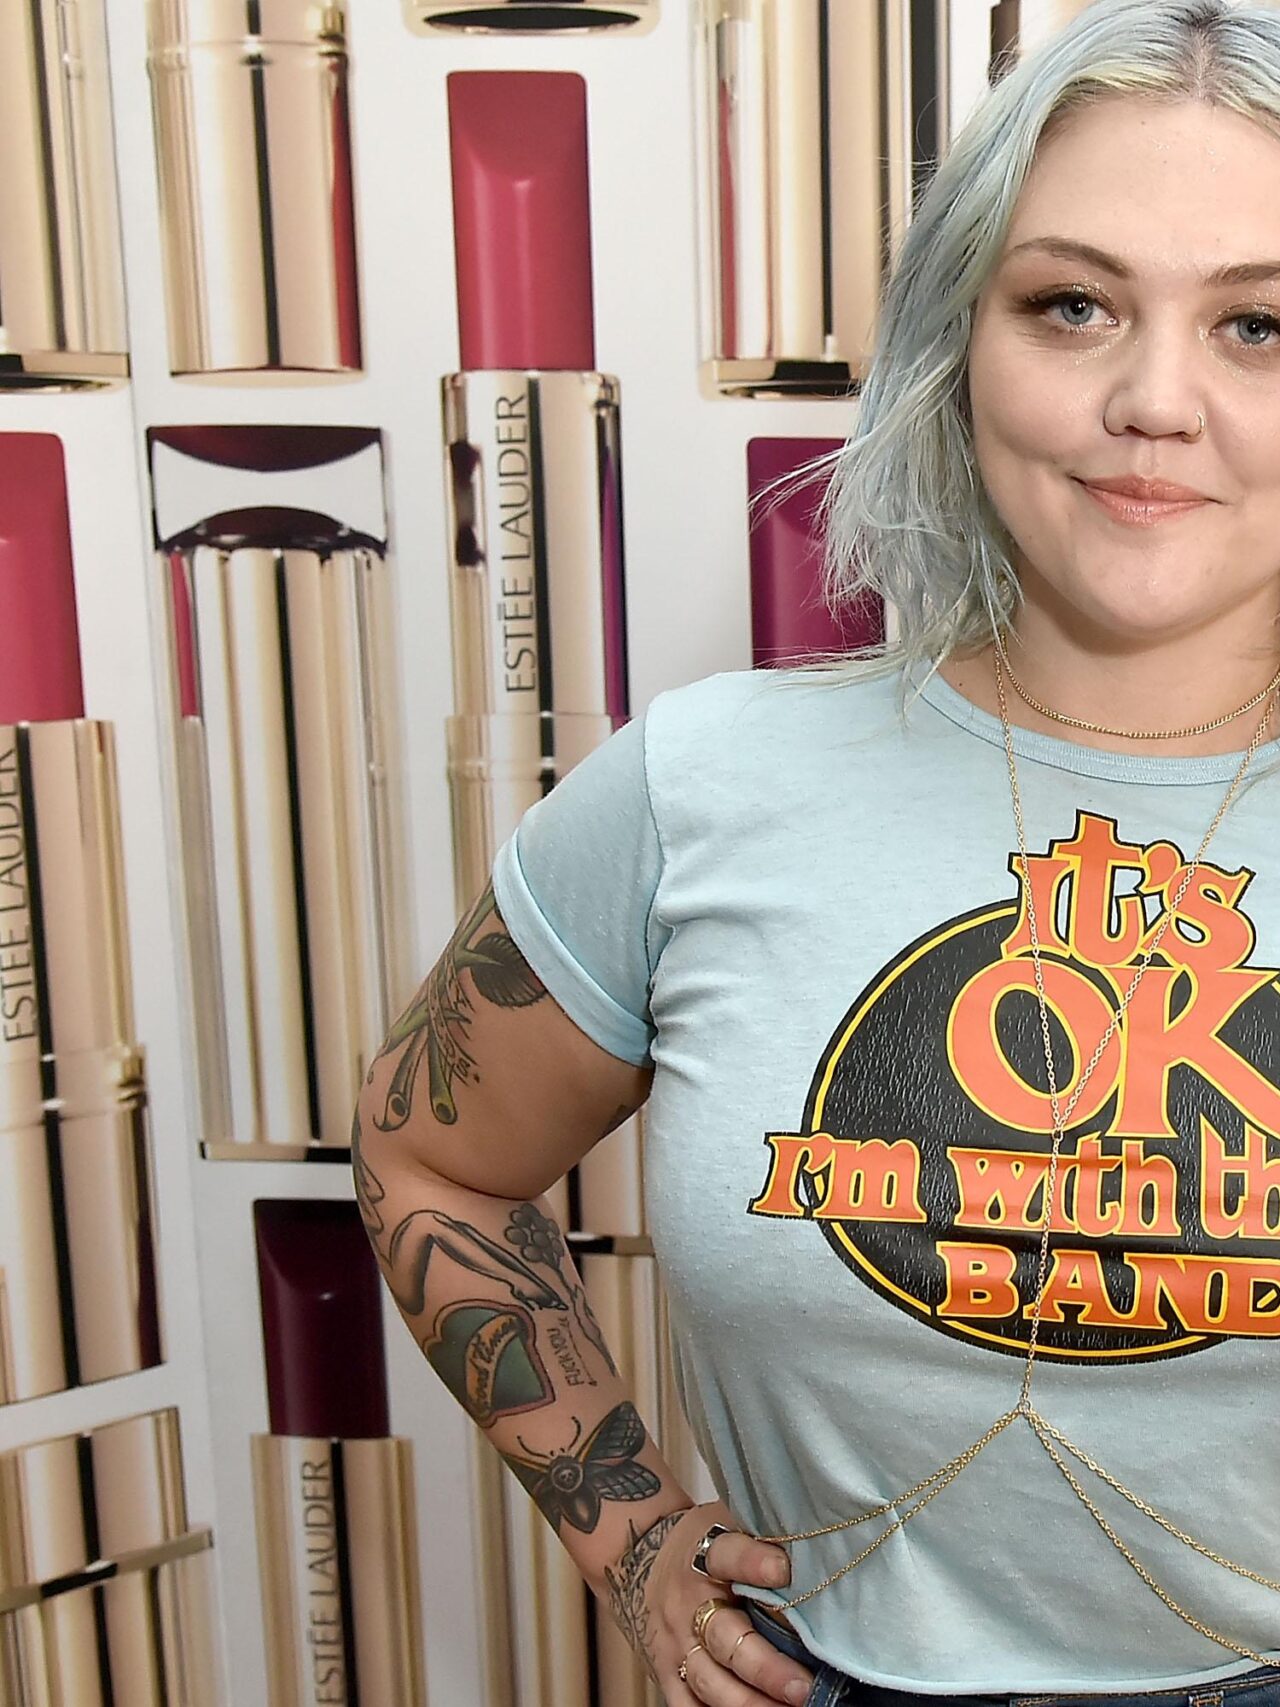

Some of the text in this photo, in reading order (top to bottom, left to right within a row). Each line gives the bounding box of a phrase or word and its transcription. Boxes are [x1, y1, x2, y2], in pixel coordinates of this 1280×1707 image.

[496, 394, 531, 560] LAUDER
[748, 1133, 927, 1222] I'm
[947, 1130, 1182, 1238] with
[558, 1353, 585, 1387] FUCK
[303, 1461, 337, 1595] LAUDER
